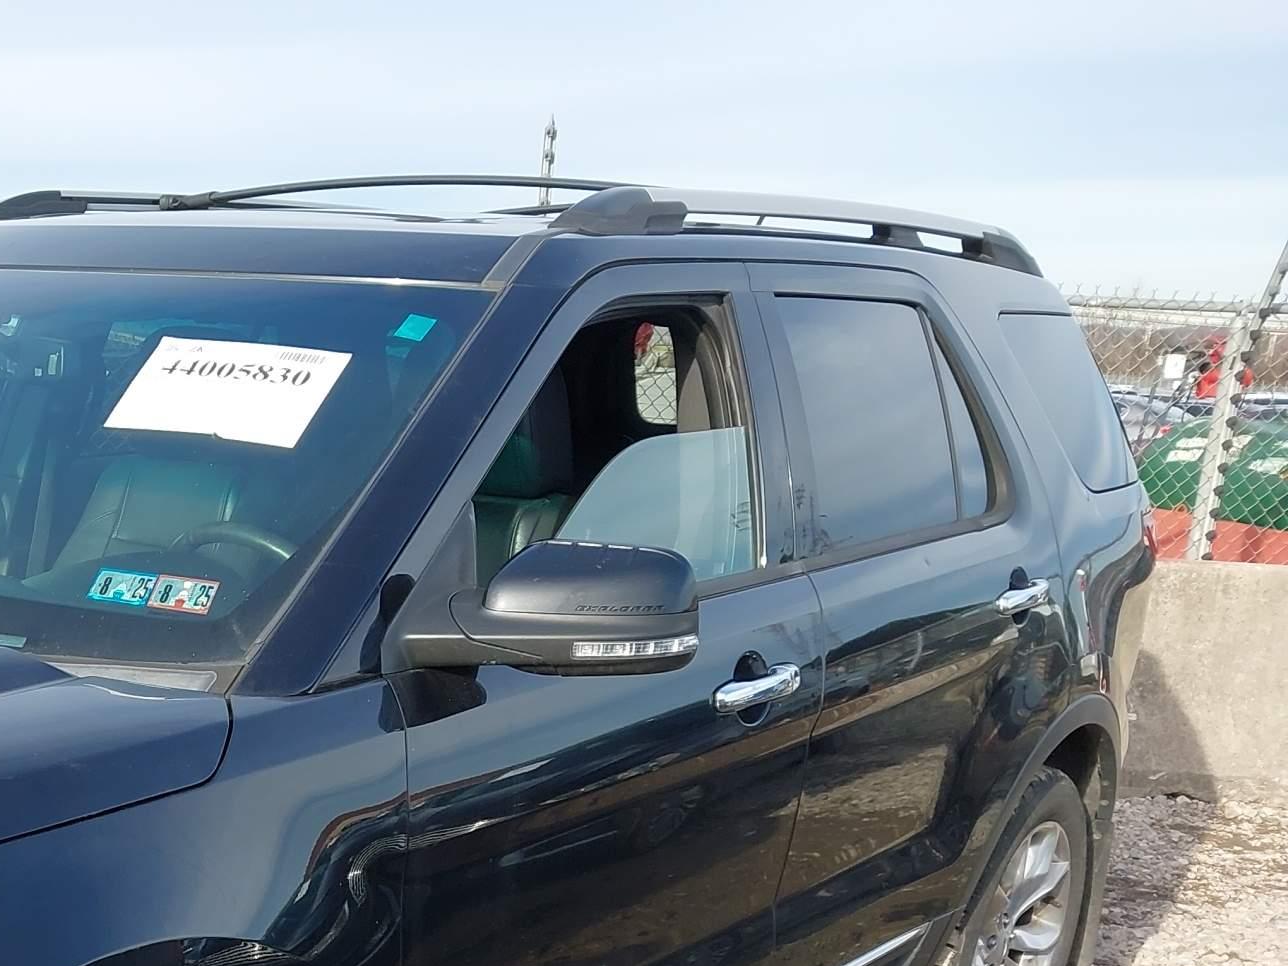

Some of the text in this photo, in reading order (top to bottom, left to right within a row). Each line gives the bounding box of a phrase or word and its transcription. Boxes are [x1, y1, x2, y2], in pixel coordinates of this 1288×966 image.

[162, 360, 311, 386] 44005830
[132, 578, 153, 600] 25
[193, 585, 214, 608] 25
